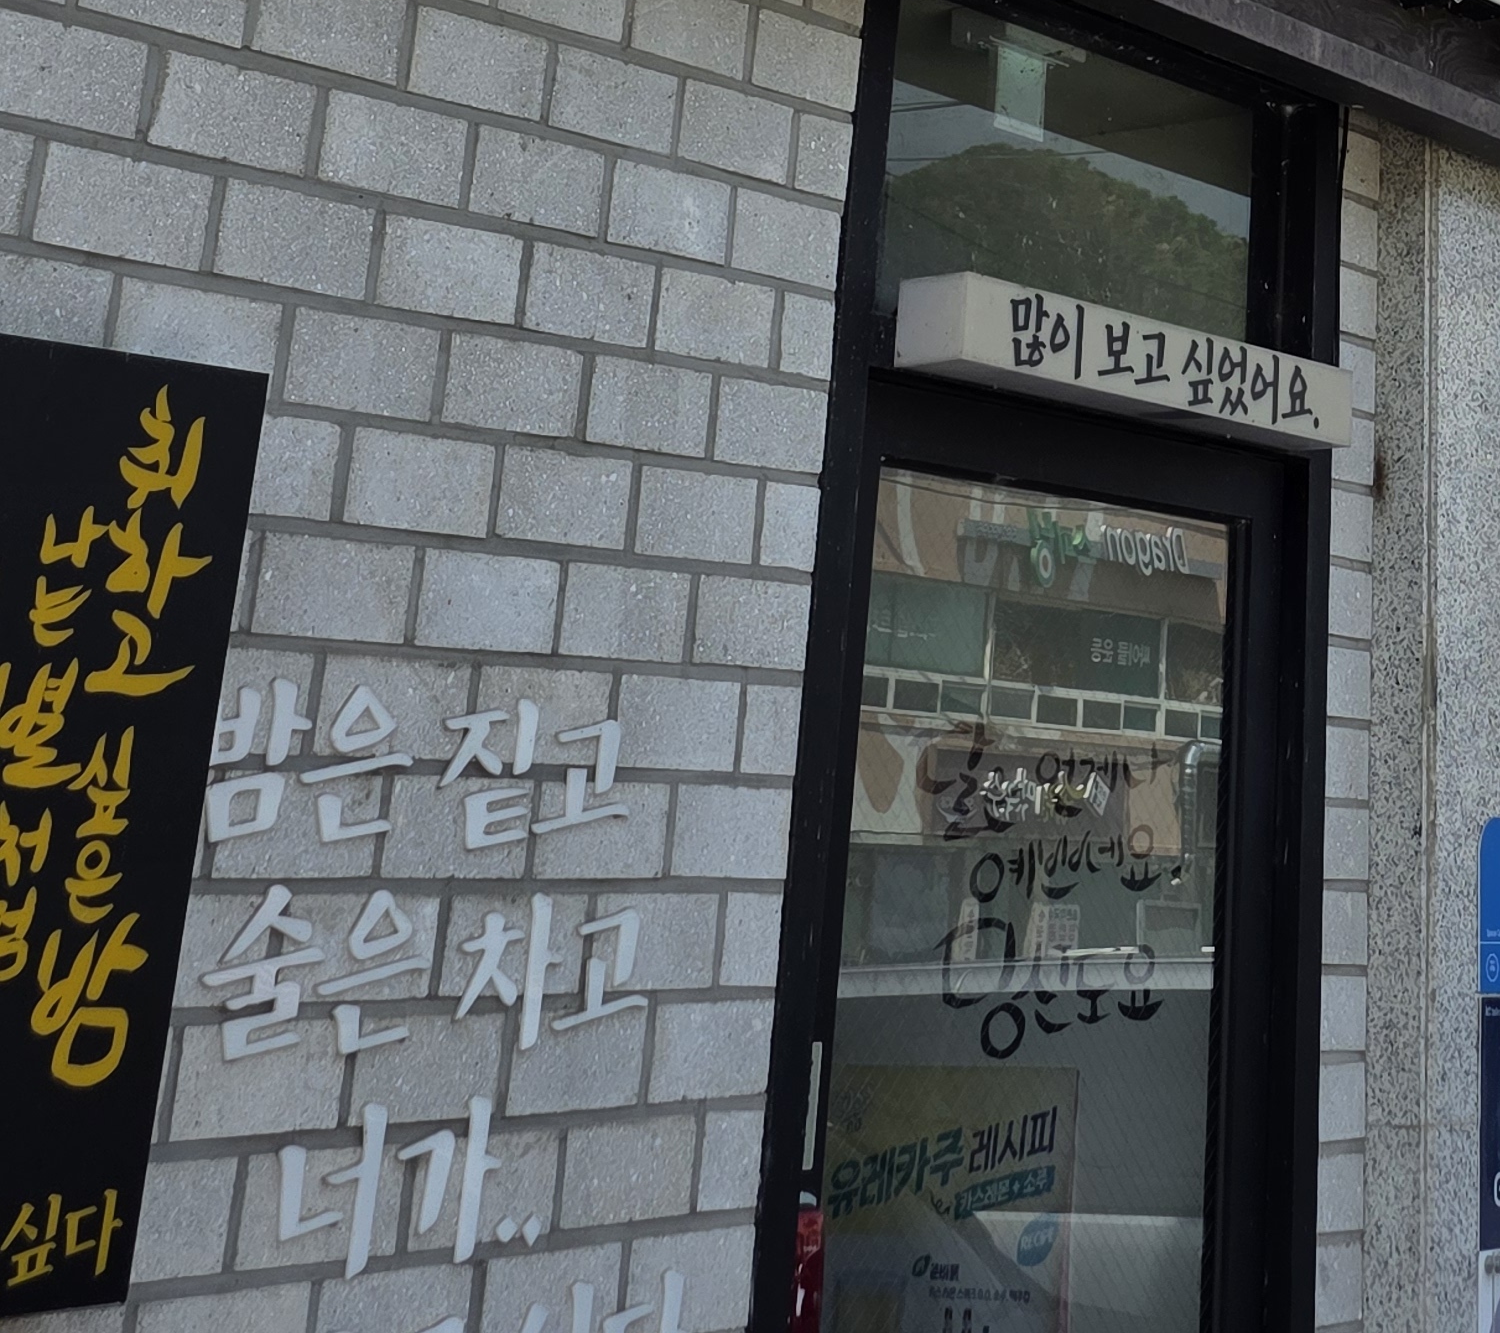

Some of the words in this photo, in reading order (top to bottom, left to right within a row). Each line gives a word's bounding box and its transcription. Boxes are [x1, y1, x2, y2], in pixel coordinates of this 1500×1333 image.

[1009, 293, 1085, 381] 많이
[1097, 321, 1171, 385] 보고
[1181, 336, 1320, 430] 싶었어요.
[70, 725, 136, 924] 싶은
[203, 677, 413, 846] 밤은
[438, 698, 630, 851] 짙고
[29, 910, 148, 1088] 밤
[202, 883, 431, 1062] 술은
[456, 891, 649, 1051] 차고
[828, 1126, 966, 1220] 유레카주
[968, 1105, 1058, 1175] 레시피
